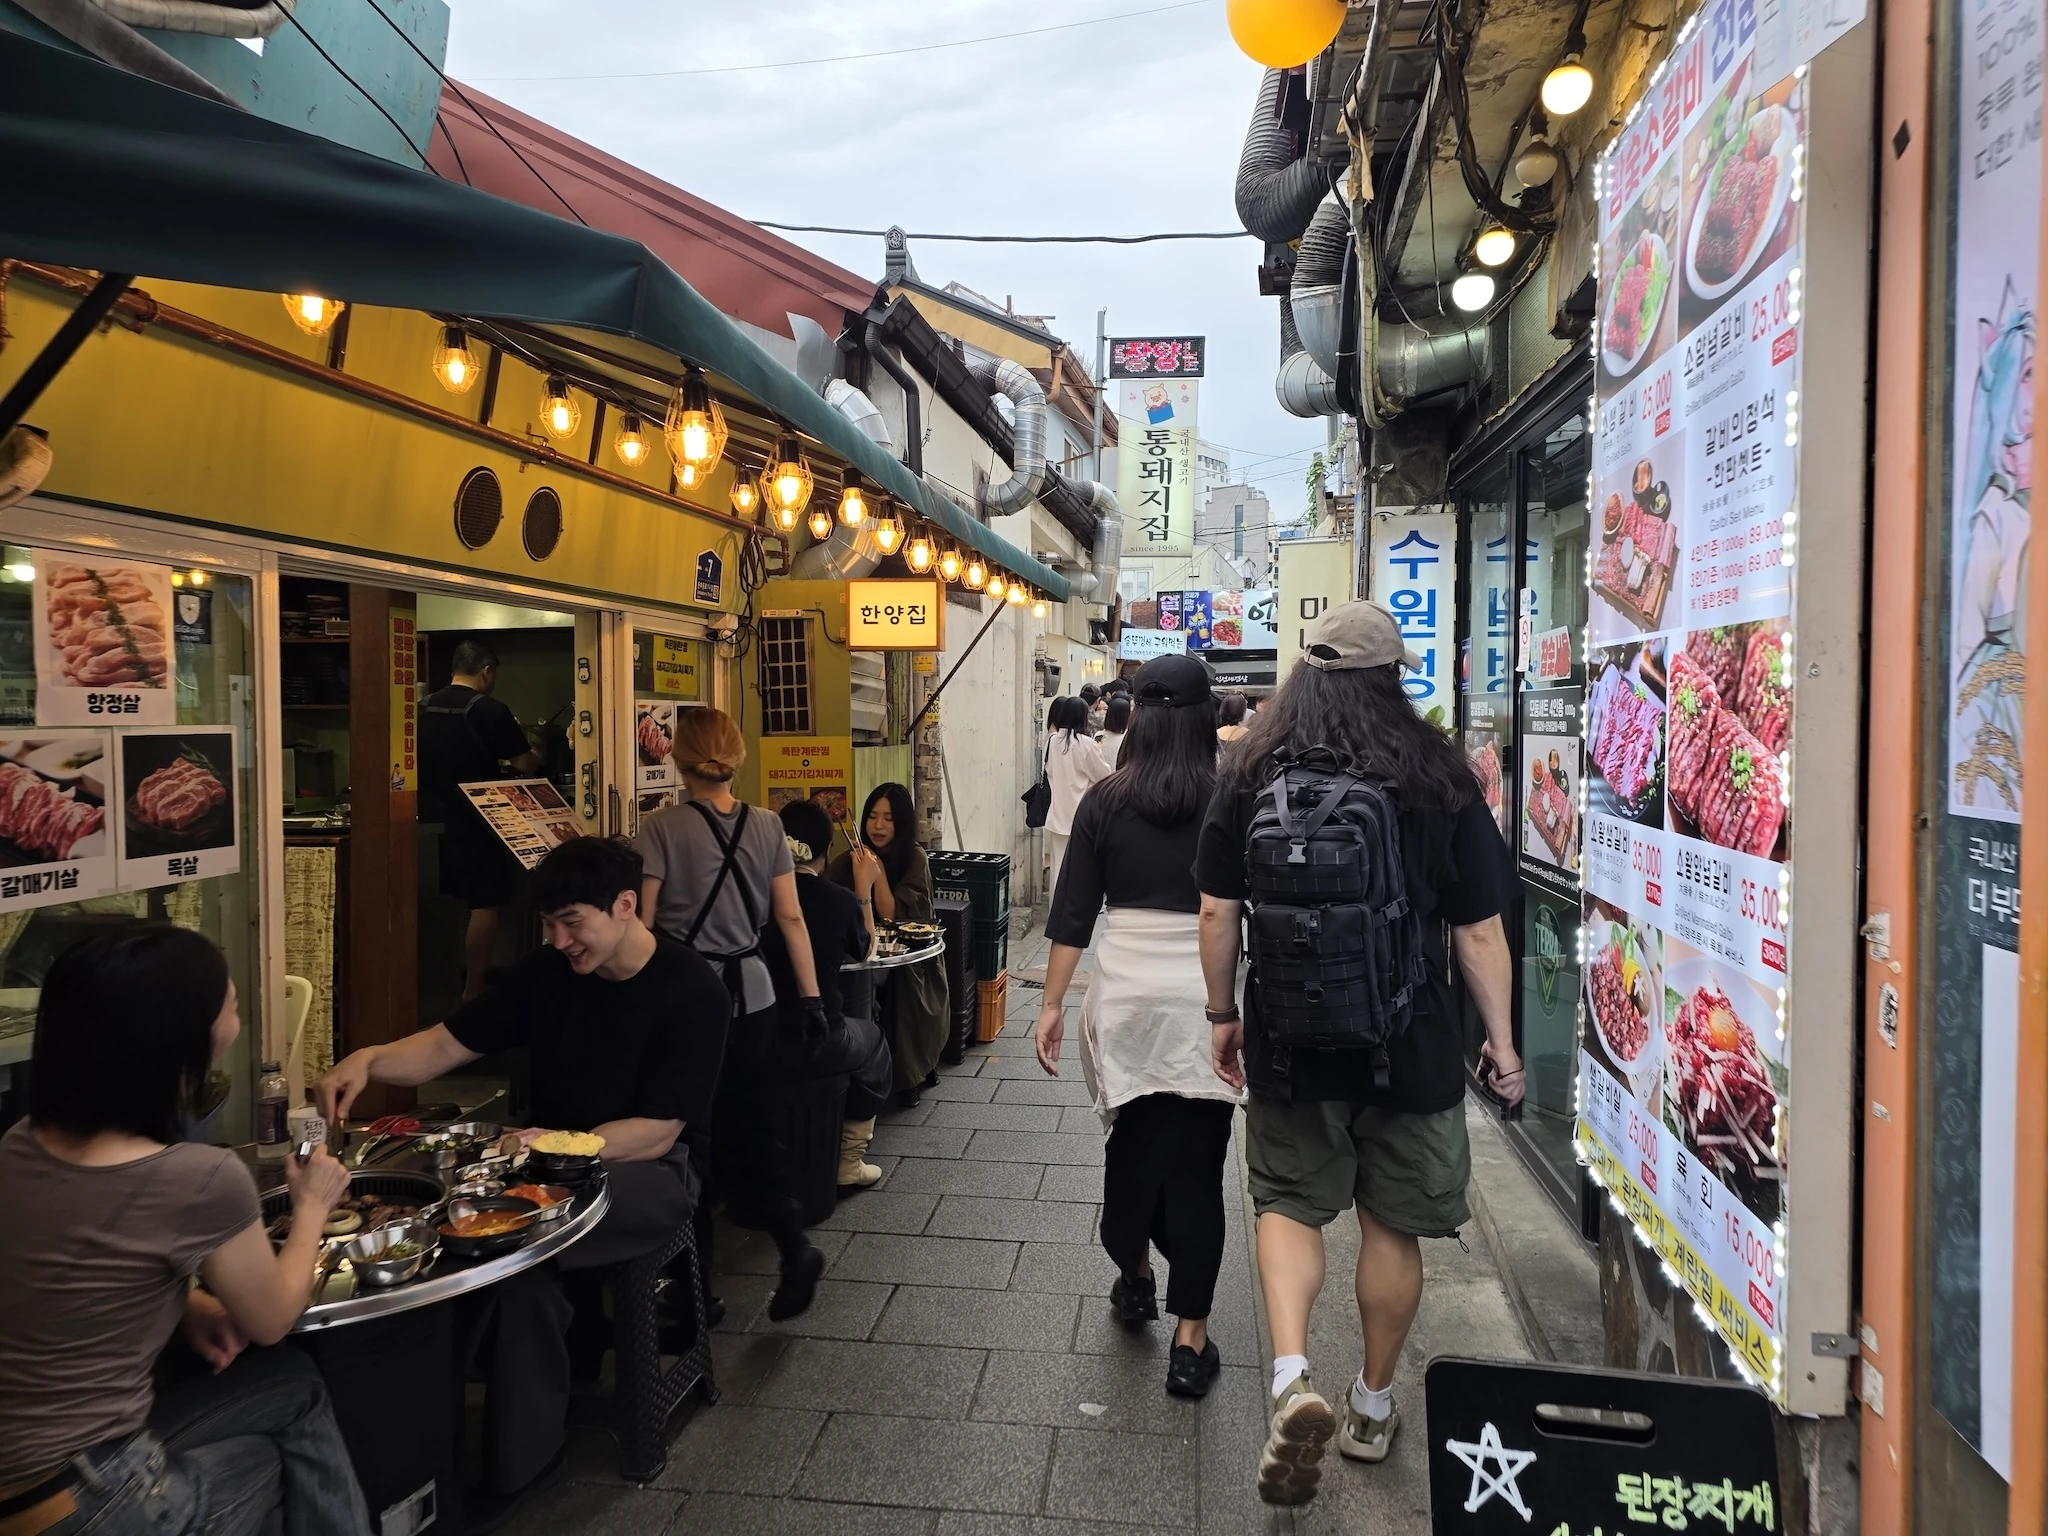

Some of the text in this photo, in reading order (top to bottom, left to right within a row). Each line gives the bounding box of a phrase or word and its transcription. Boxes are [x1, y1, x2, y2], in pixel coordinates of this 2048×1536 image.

[1977, 7, 2038, 80] 100%
[1752, 277, 1792, 342] 25,00
[1684, 300, 1746, 377] 소양념갈비
[1601, 388, 1637, 438] 소생갈비
[1642, 370, 1671, 420] 25,000
[1705, 388, 1775, 457] 갈비의정석
[1138, 429, 1177, 541] 통돼지집
[1179, 459, 1189, 486] 생고기
[1710, 502, 1765, 531] Galbi Set Menu
[860, 605, 926, 625] 한양집
[87, 693, 141, 714] 항정살
[645, 769, 666, 781] 갈매기살
[768, 769, 844, 779] 돼지고기김치찌개
[781, 746, 830, 757] 폭탄계란찜
[1591, 819, 1630, 855] 소왕생갈비
[1632, 840, 1662, 880] 35,000
[1, 868, 80, 898] 갈매기살
[167, 856, 199, 877] 목살
[1676, 848, 1731, 896] 소왕양념갈비
[1741, 878, 1786, 934] 35,00
[1968, 877, 1987, 917] 더
[1534, 921, 1560, 969] TERRA
[1589, 1062, 1622, 1114] 생갈비살
[1628, 1109, 1658, 1166] 25,000
[1723, 1208, 1774, 1288] 15,000
[1622, 1175, 1669, 1258] 된장찌개,
[1674, 1244, 1713, 1310] 계란찜
[1718, 1300, 1767, 1374] 써비스
[1750, 1284, 1774, 1328] 150g
[1616, 1471, 1775, 1533] 된장찌개
